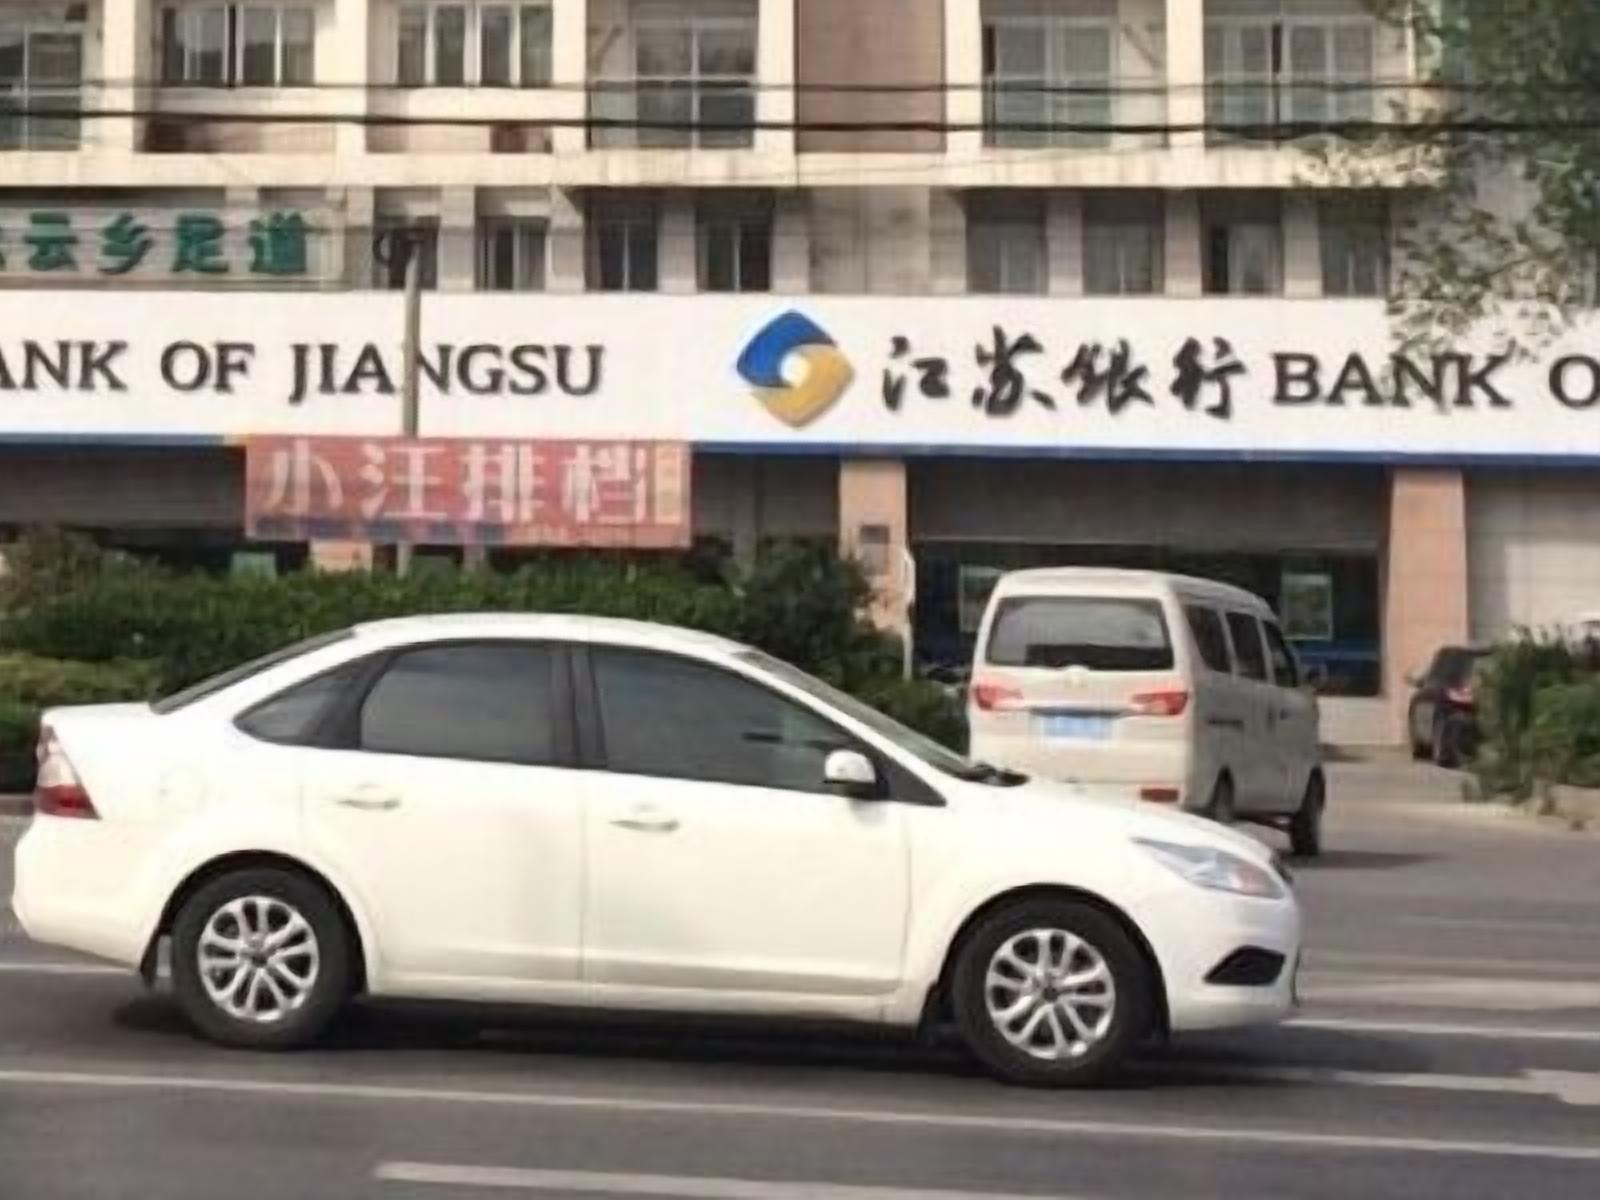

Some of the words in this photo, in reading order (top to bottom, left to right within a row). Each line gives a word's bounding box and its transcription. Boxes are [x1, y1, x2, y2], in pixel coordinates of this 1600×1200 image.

[159, 340, 255, 393] OF
[288, 342, 606, 406] JIANGSU
[880, 324, 1248, 420] 江苏银行
[1272, 351, 1514, 412] BANK
